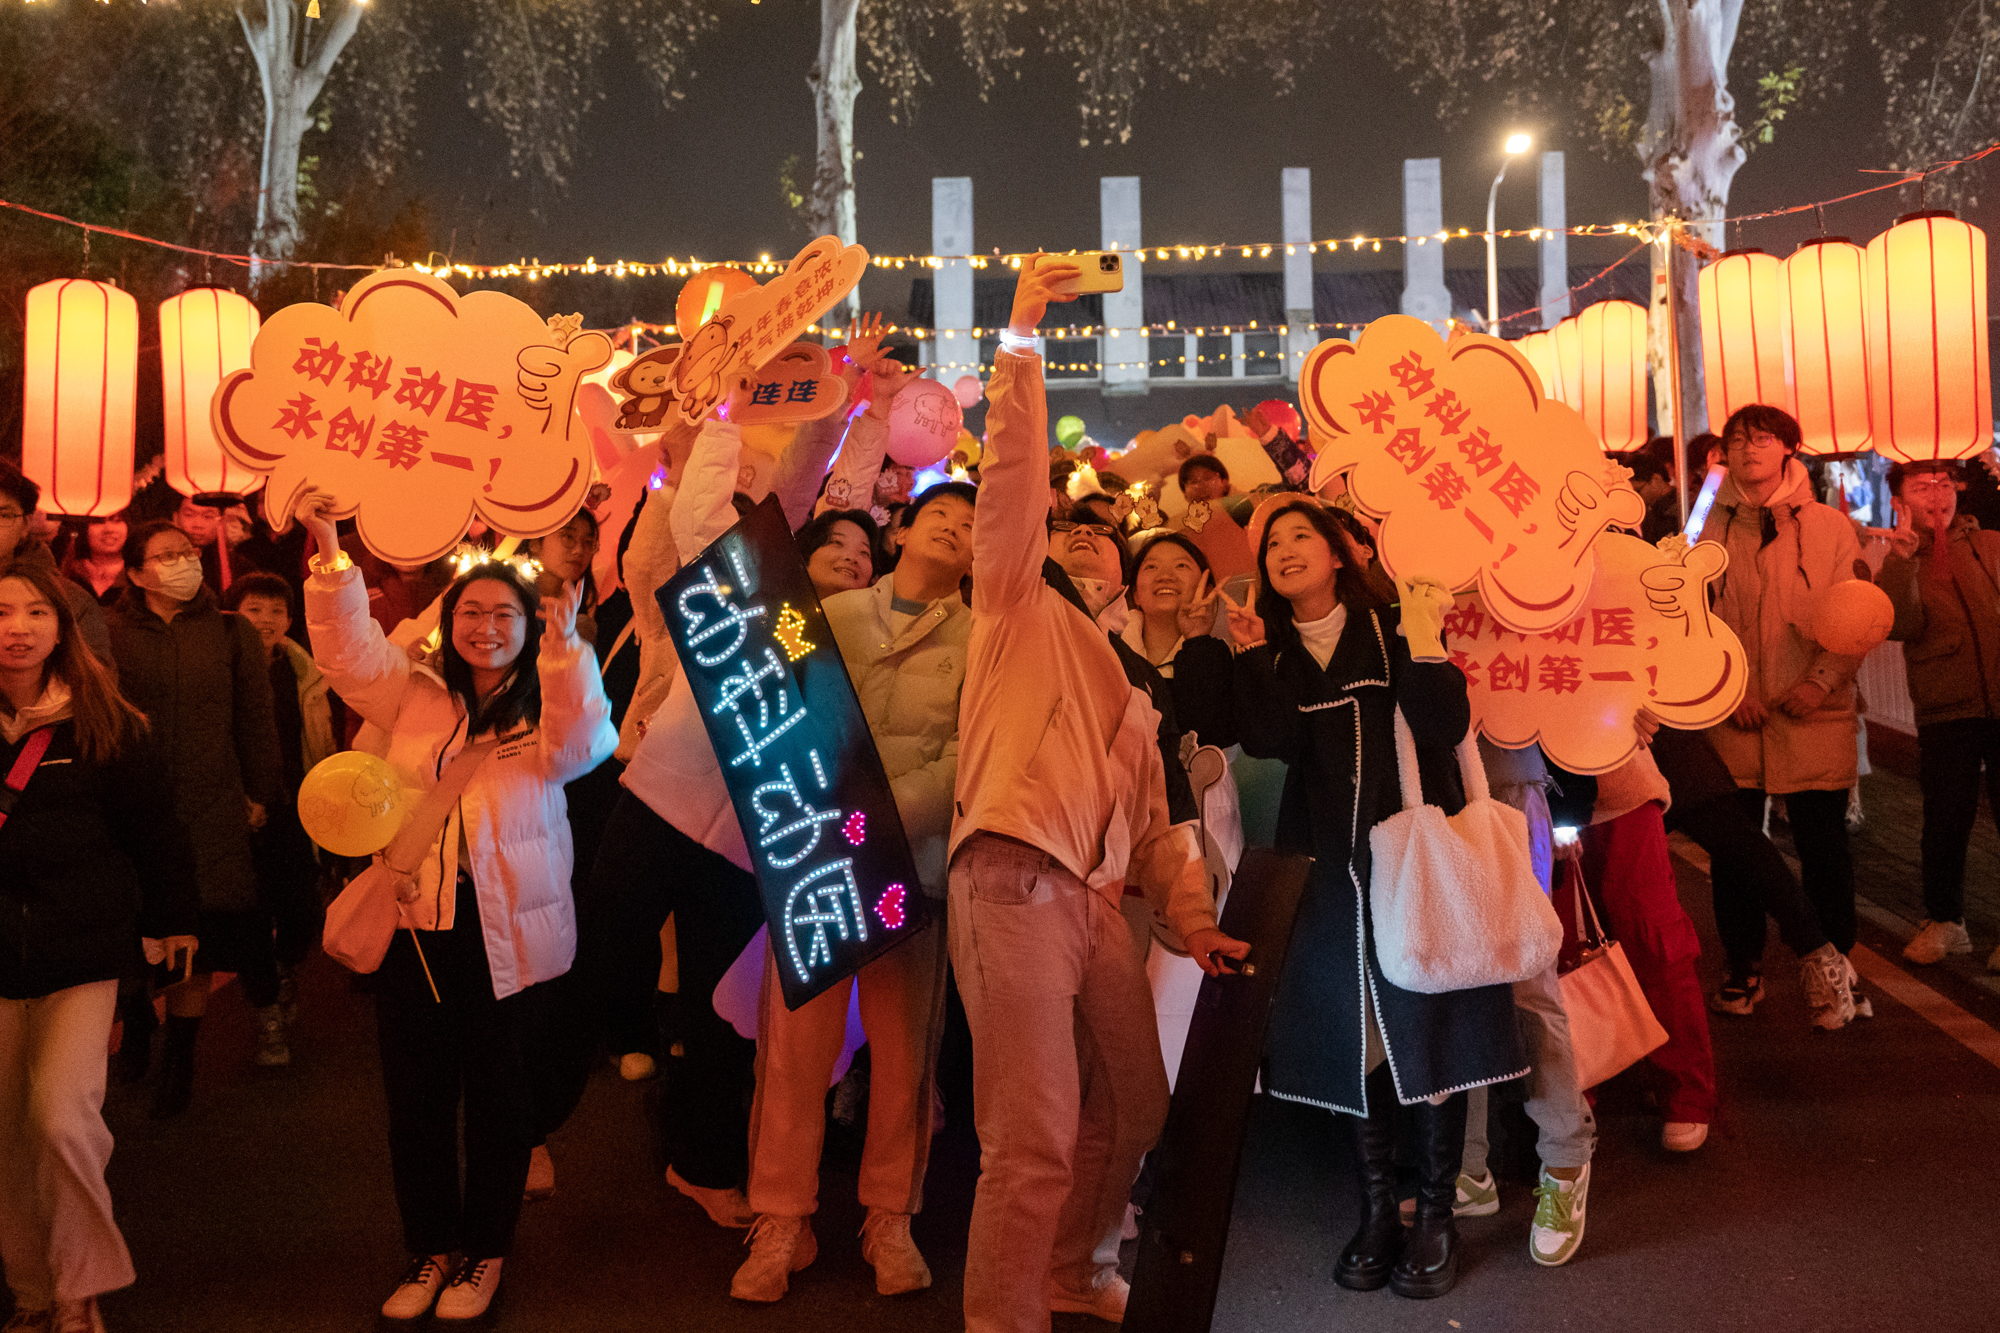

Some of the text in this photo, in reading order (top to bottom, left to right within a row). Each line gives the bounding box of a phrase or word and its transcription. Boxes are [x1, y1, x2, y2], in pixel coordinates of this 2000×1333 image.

[749, 379, 820, 406] 连连
[678, 550, 869, 984] 动科动医
